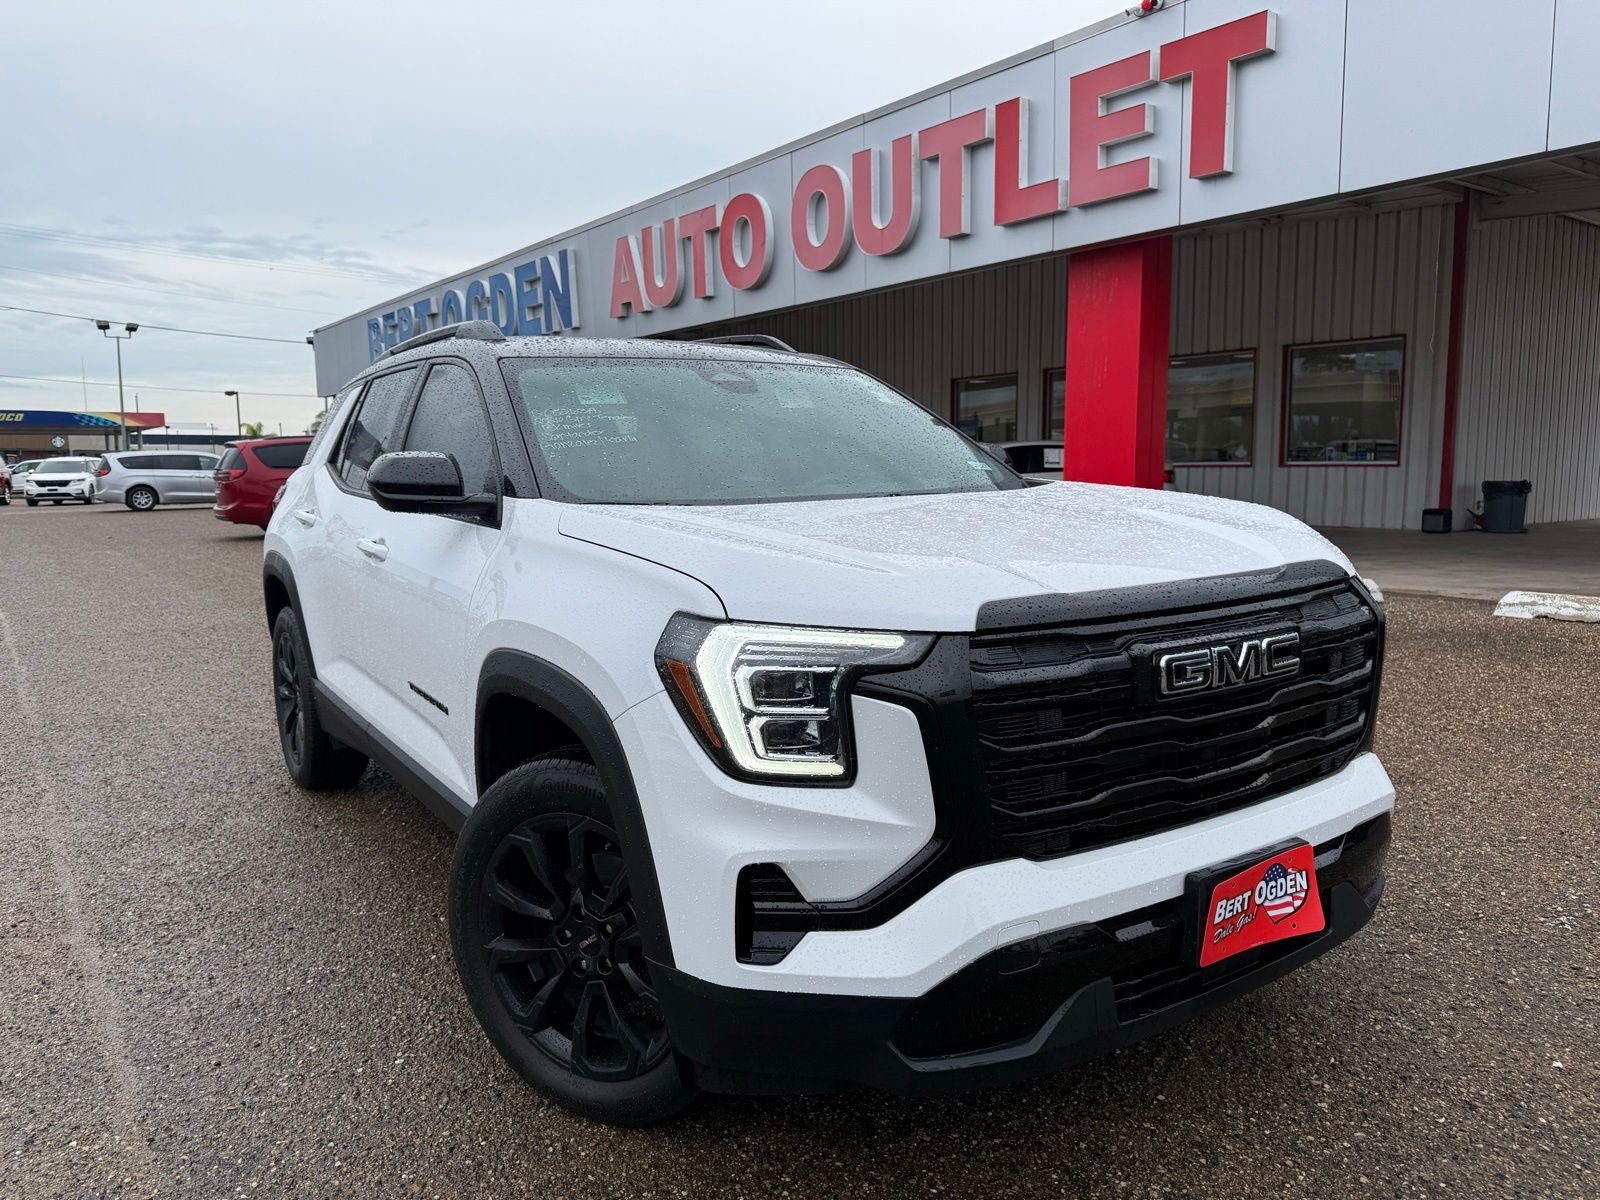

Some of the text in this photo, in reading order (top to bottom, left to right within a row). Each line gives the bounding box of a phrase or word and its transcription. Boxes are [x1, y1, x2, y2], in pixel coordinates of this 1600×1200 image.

[367, 9, 1277, 364] BERT OGDEN AUTO OUTLET
[1159, 632, 1300, 694] GMC
[1213, 870, 1308, 925] BERT OGDEN
